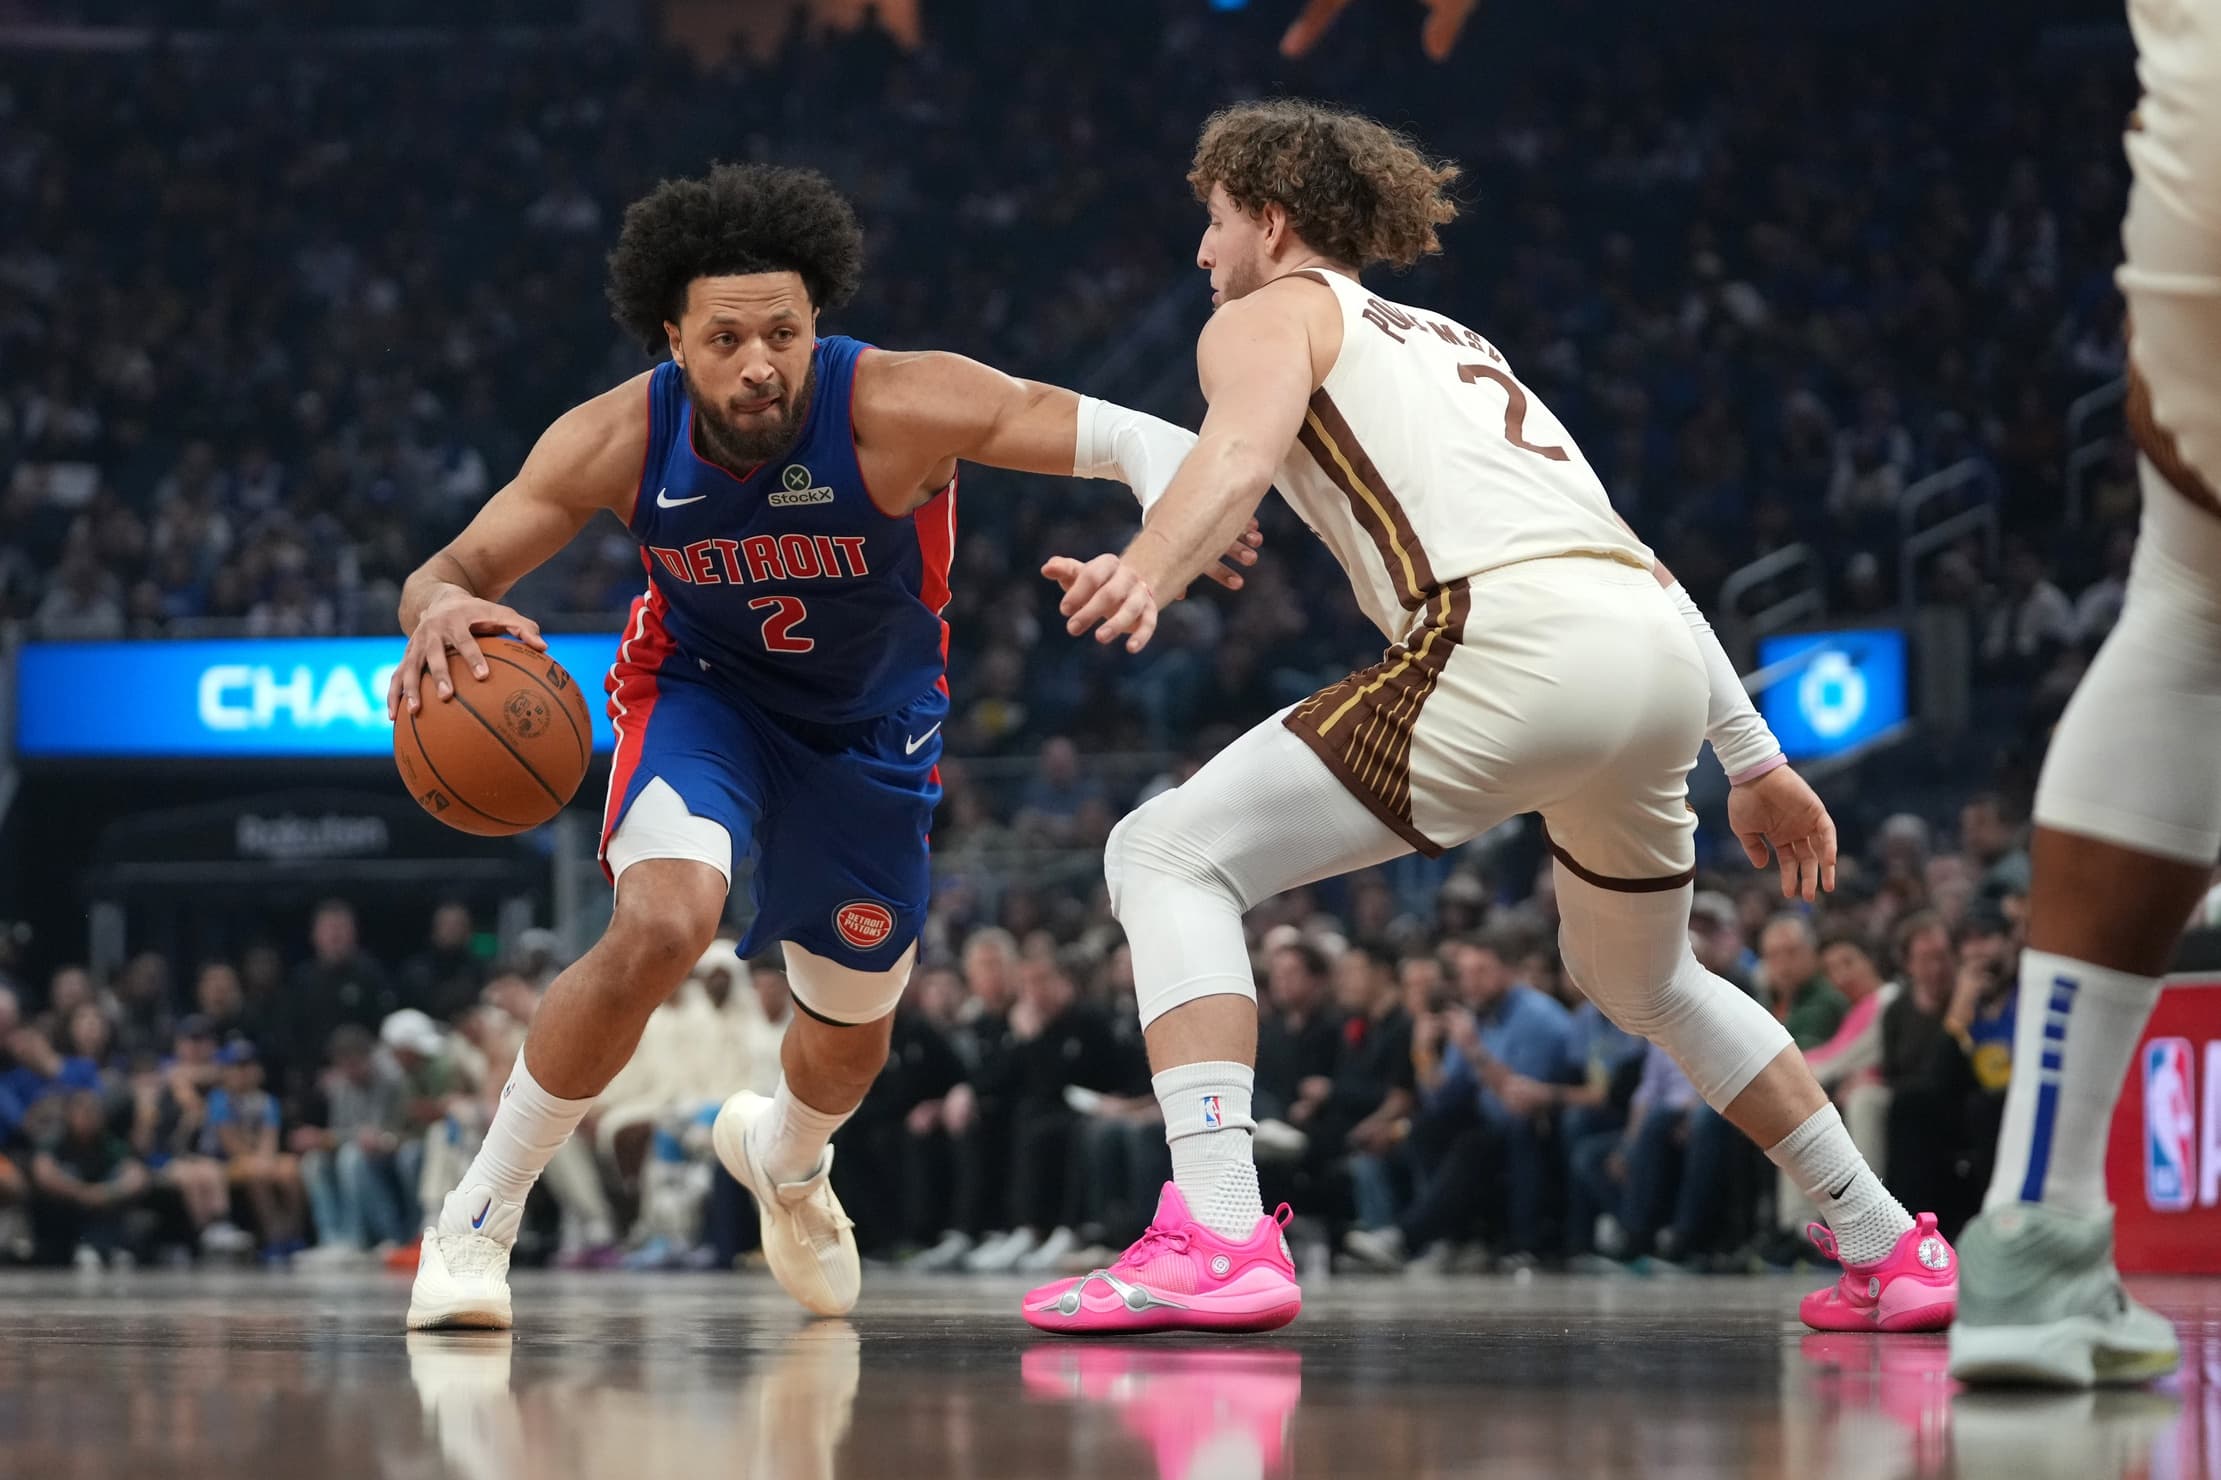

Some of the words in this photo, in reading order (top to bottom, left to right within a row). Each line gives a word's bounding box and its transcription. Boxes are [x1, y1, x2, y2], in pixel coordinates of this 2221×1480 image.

[1457, 361, 1571, 462] 2
[770, 488, 832, 505] StockX
[650, 533, 869, 585] DETROIT
[748, 596, 815, 653] 2
[844, 919, 881, 936] PISTONS
[848, 912, 885, 928] DETROIT
